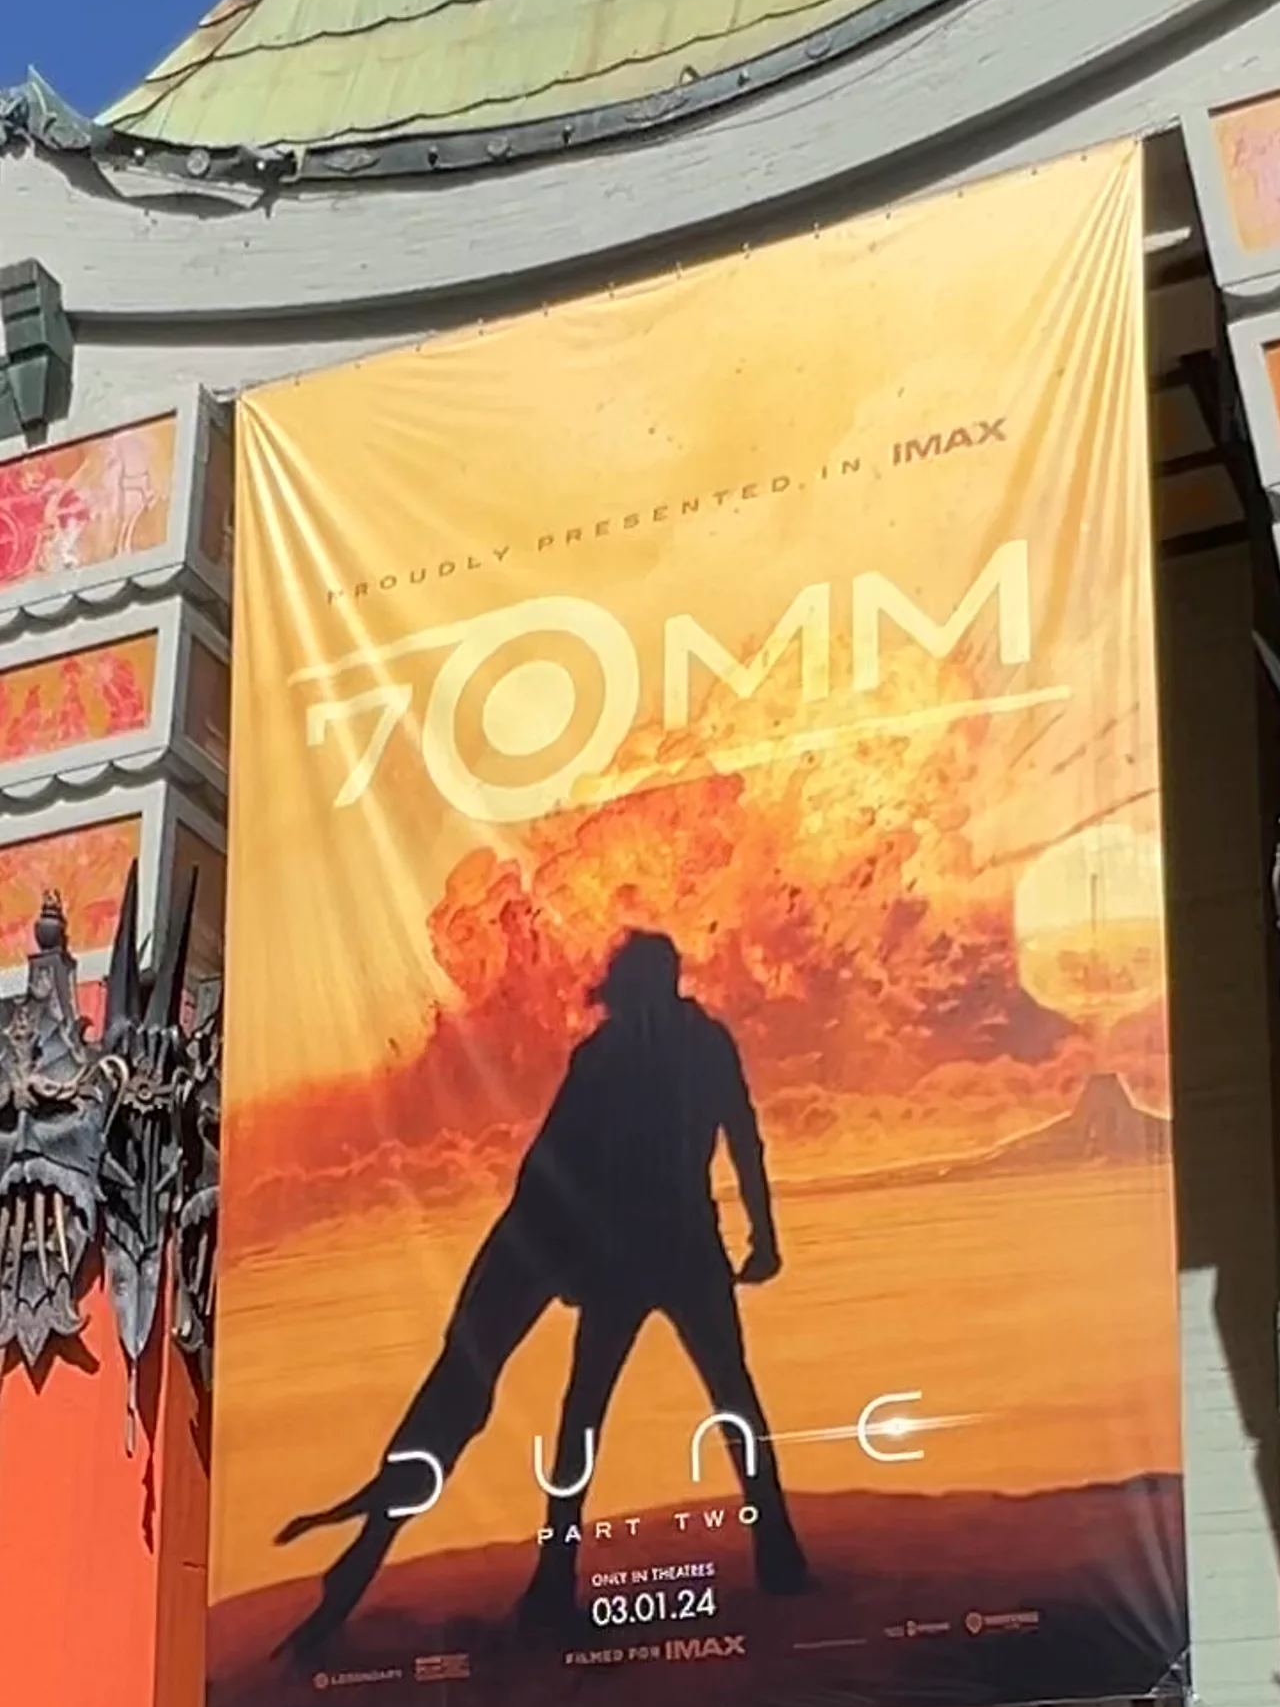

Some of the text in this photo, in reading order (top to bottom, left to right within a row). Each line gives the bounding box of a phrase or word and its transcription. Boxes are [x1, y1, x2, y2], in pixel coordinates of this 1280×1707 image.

[326, 416, 1008, 607] PROUDLY PRESENTED IN IMAX
[290, 539, 1032, 824] 70MM
[536, 1505, 760, 1545] PART TWO
[591, 1562, 716, 1588] ONLY IN THEATRES
[591, 1587, 717, 1626] 03.01.24
[565, 1635, 746, 1666] FILMED FOR IMAX
